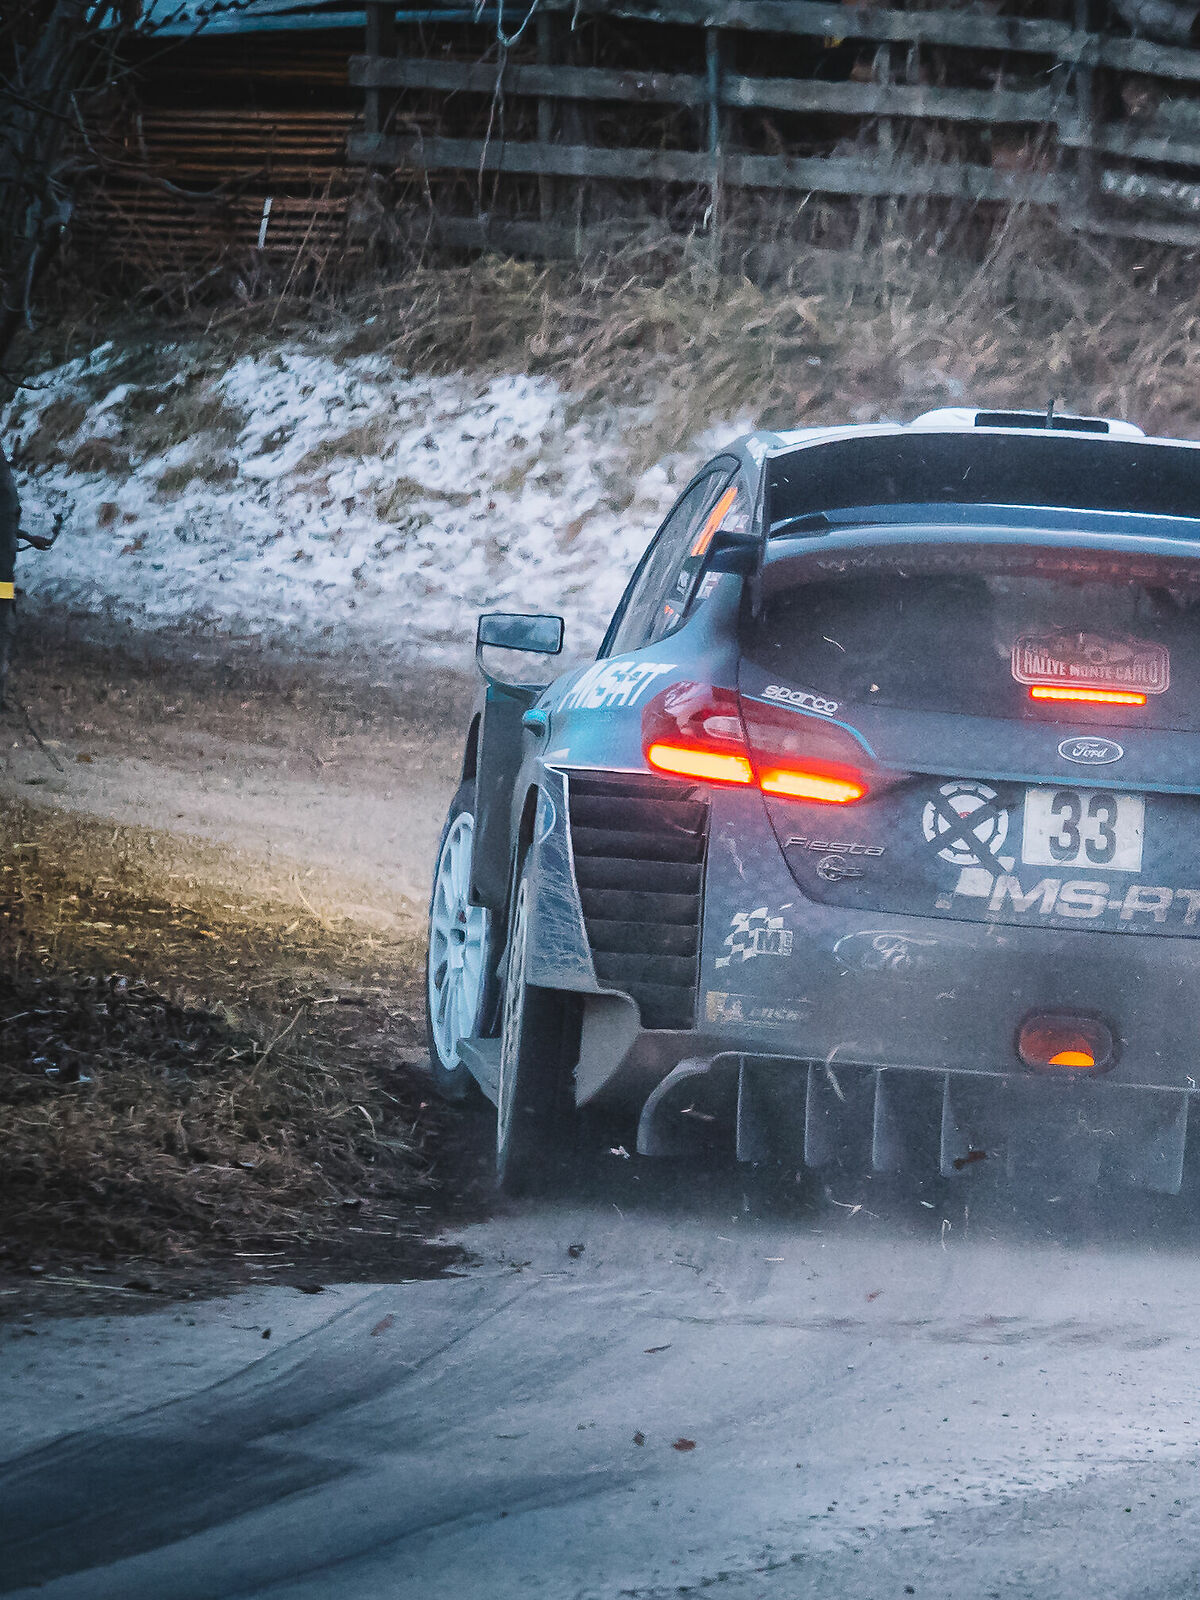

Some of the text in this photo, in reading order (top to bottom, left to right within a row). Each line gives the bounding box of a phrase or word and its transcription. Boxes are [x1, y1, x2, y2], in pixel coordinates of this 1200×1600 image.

[1024, 650, 1067, 676] RALLYE
[764, 685, 839, 715] sparco
[1049, 791, 1118, 864] 33
[785, 837, 885, 857] Fiesta
